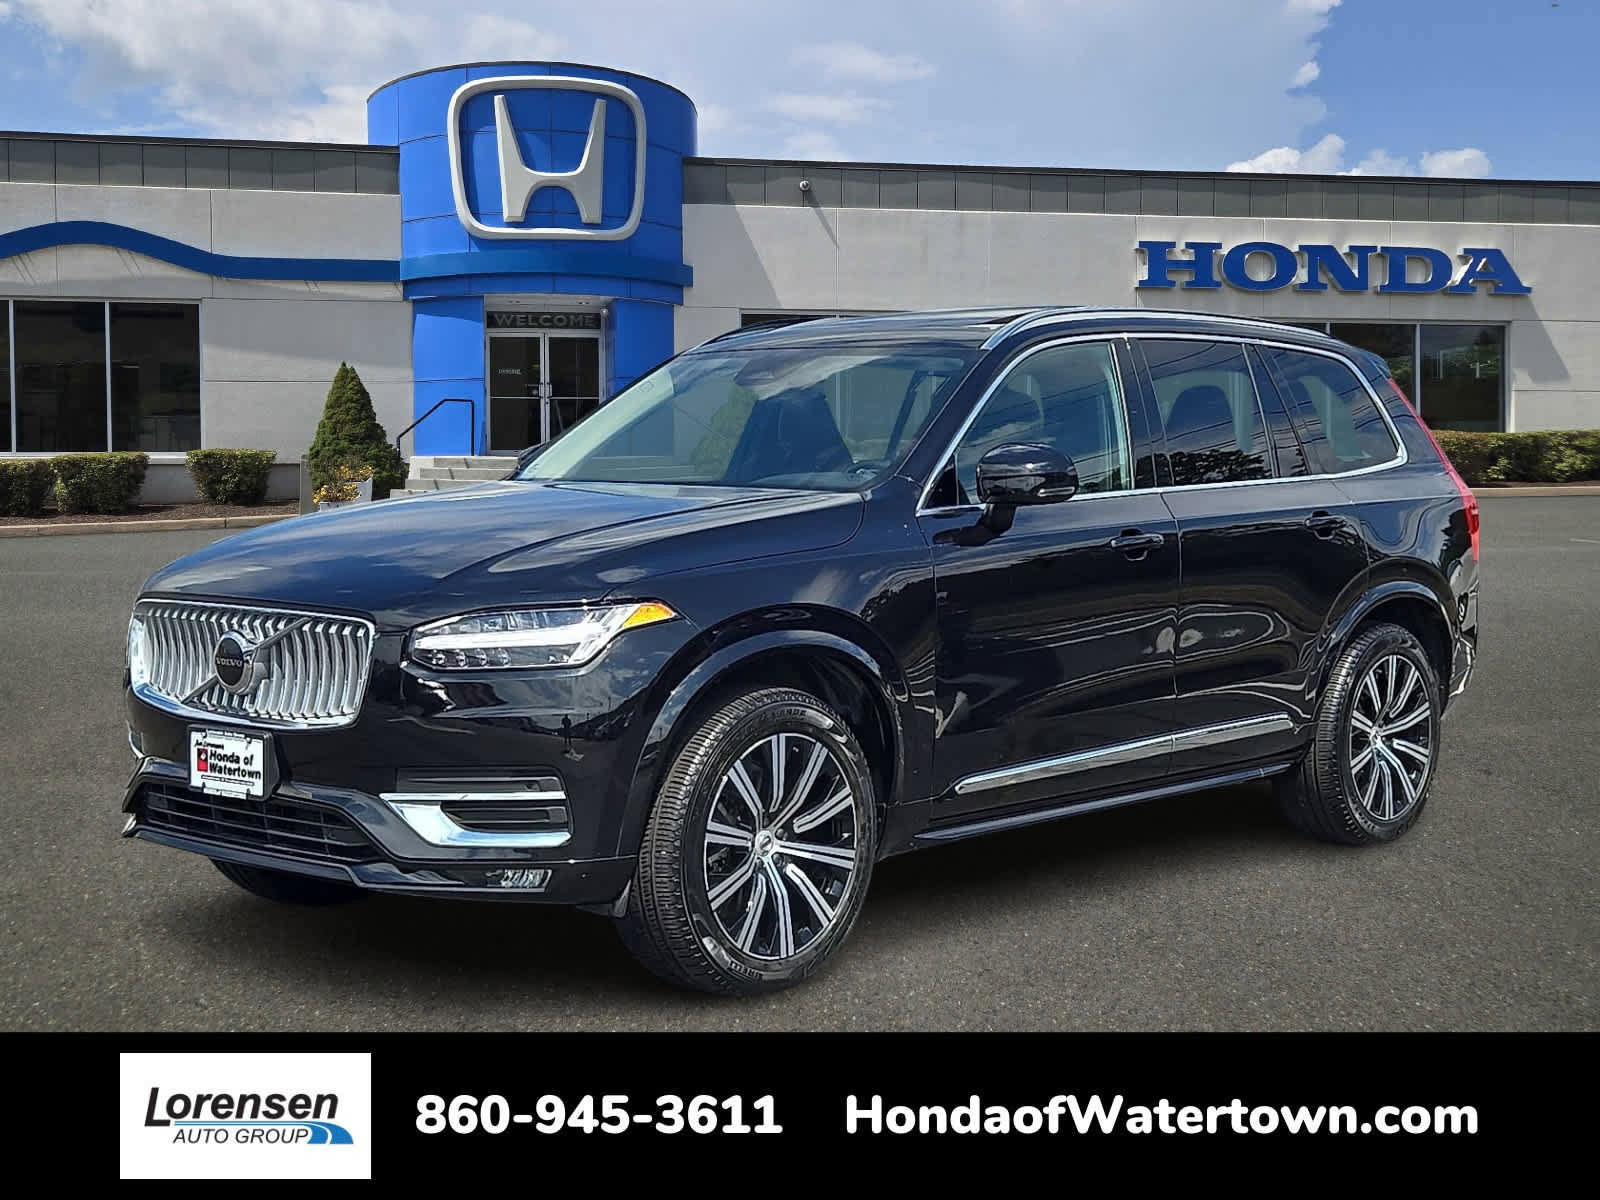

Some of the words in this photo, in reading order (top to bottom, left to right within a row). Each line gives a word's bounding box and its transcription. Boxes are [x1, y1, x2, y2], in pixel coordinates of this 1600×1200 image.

[1138, 241, 1532, 296] HONDA
[494, 313, 596, 328] WELCOME
[215, 656, 243, 668] VOLVO
[209, 749, 241, 765] Honda
[243, 754, 254, 767] of
[209, 762, 262, 780] Watertown
